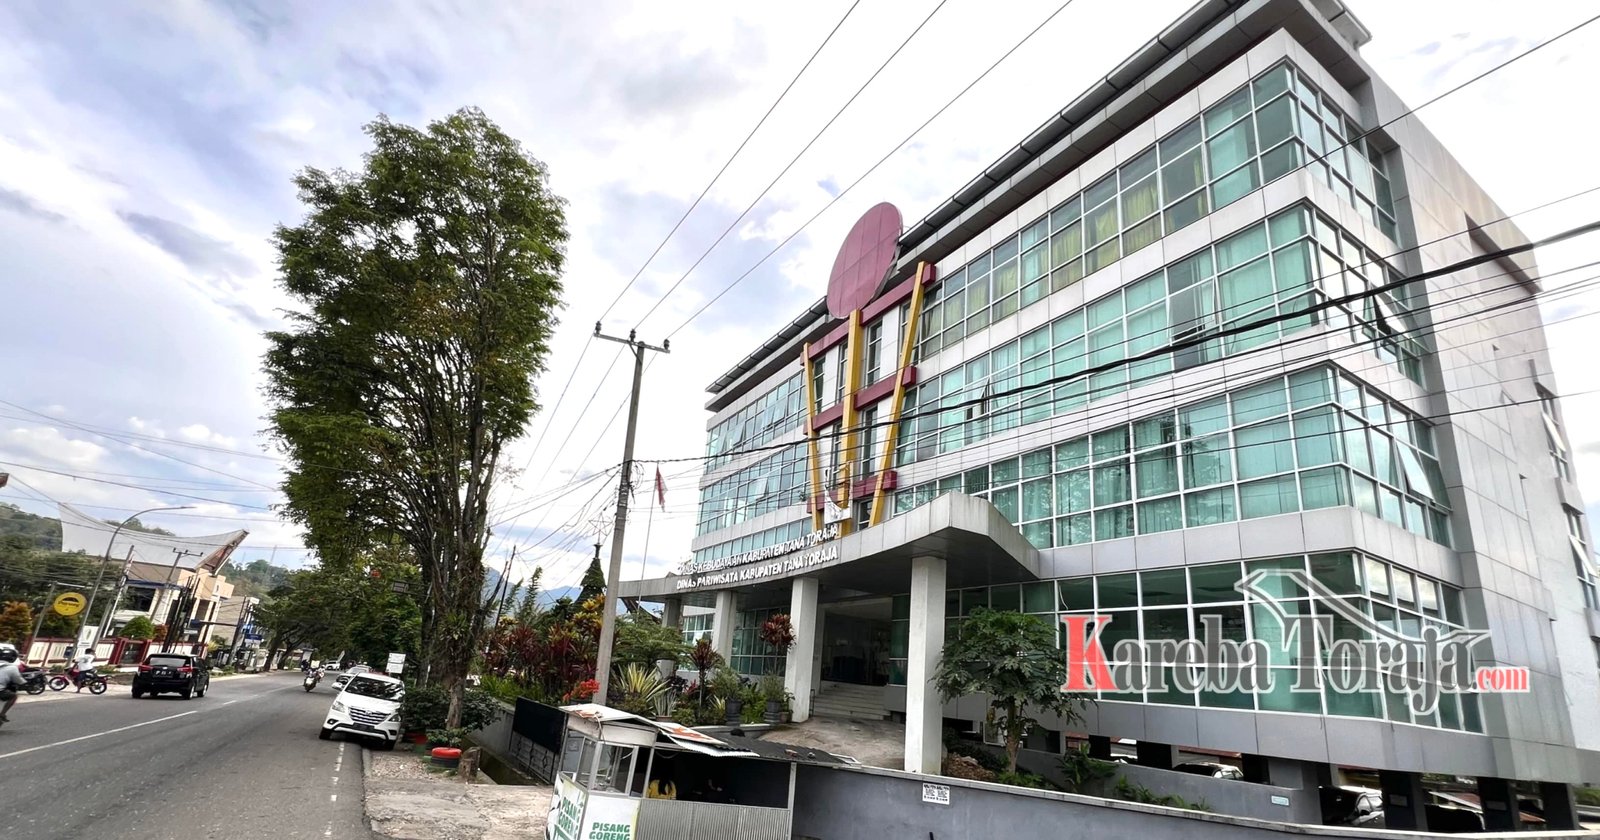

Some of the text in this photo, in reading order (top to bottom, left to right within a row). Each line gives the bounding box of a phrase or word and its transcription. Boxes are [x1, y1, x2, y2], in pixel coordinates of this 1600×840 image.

[741, 542, 785, 562] KABUPATEN
[785, 537, 805, 553] TANA
[806, 524, 838, 546] TORAJA
[676, 545, 838, 590] DINAS PARIWISATA KABUPATEN TANA TORAJA
[588, 831, 631, 840] GORENG
[592, 821, 631, 833] PISANG
